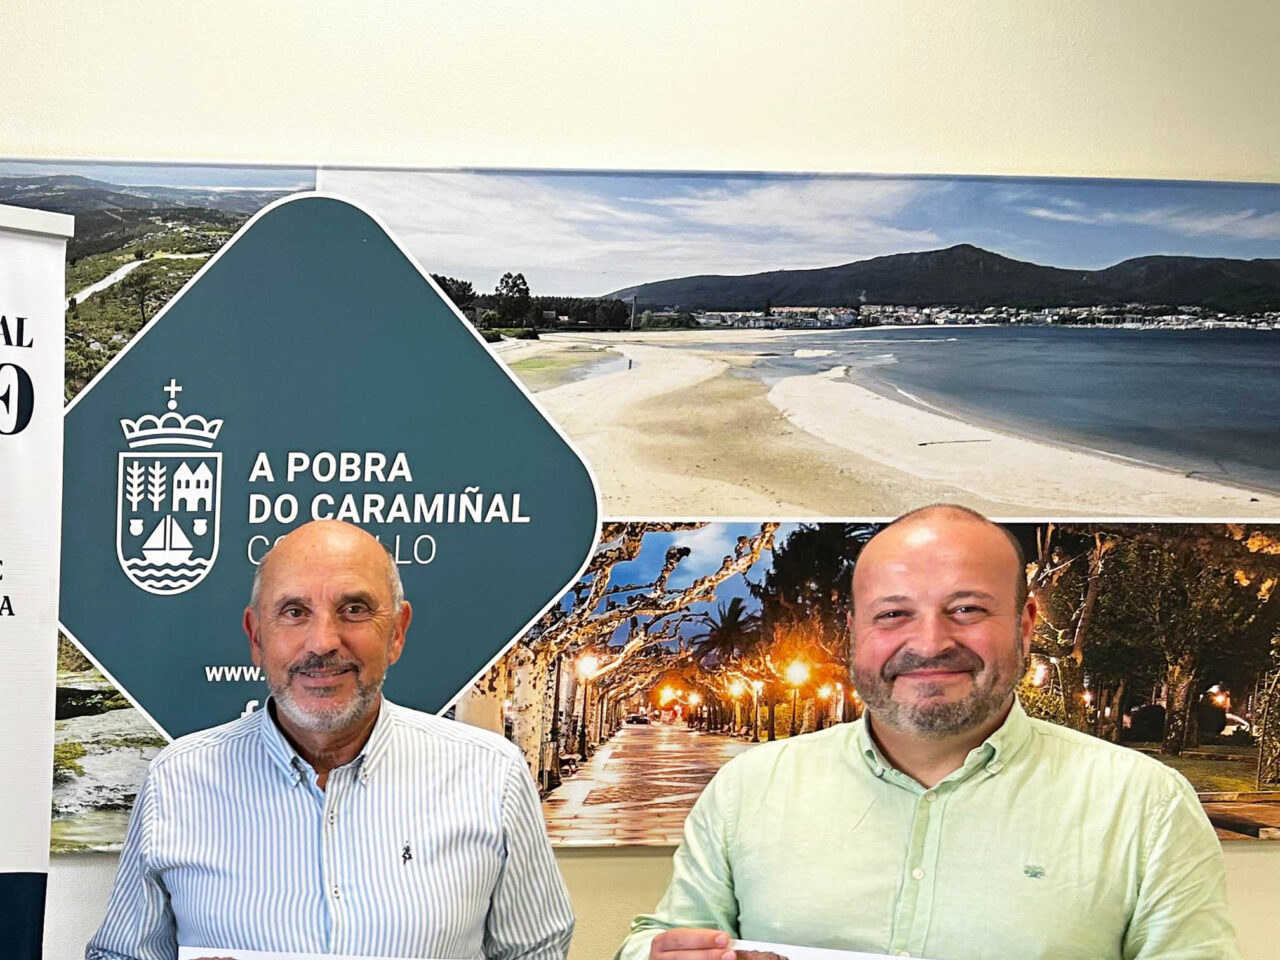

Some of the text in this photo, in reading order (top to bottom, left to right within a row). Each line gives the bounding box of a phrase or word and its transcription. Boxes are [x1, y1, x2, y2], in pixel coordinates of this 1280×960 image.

[249, 452, 412, 482] A POBRA
[249, 487, 530, 524] DO CARAMIÑAL
